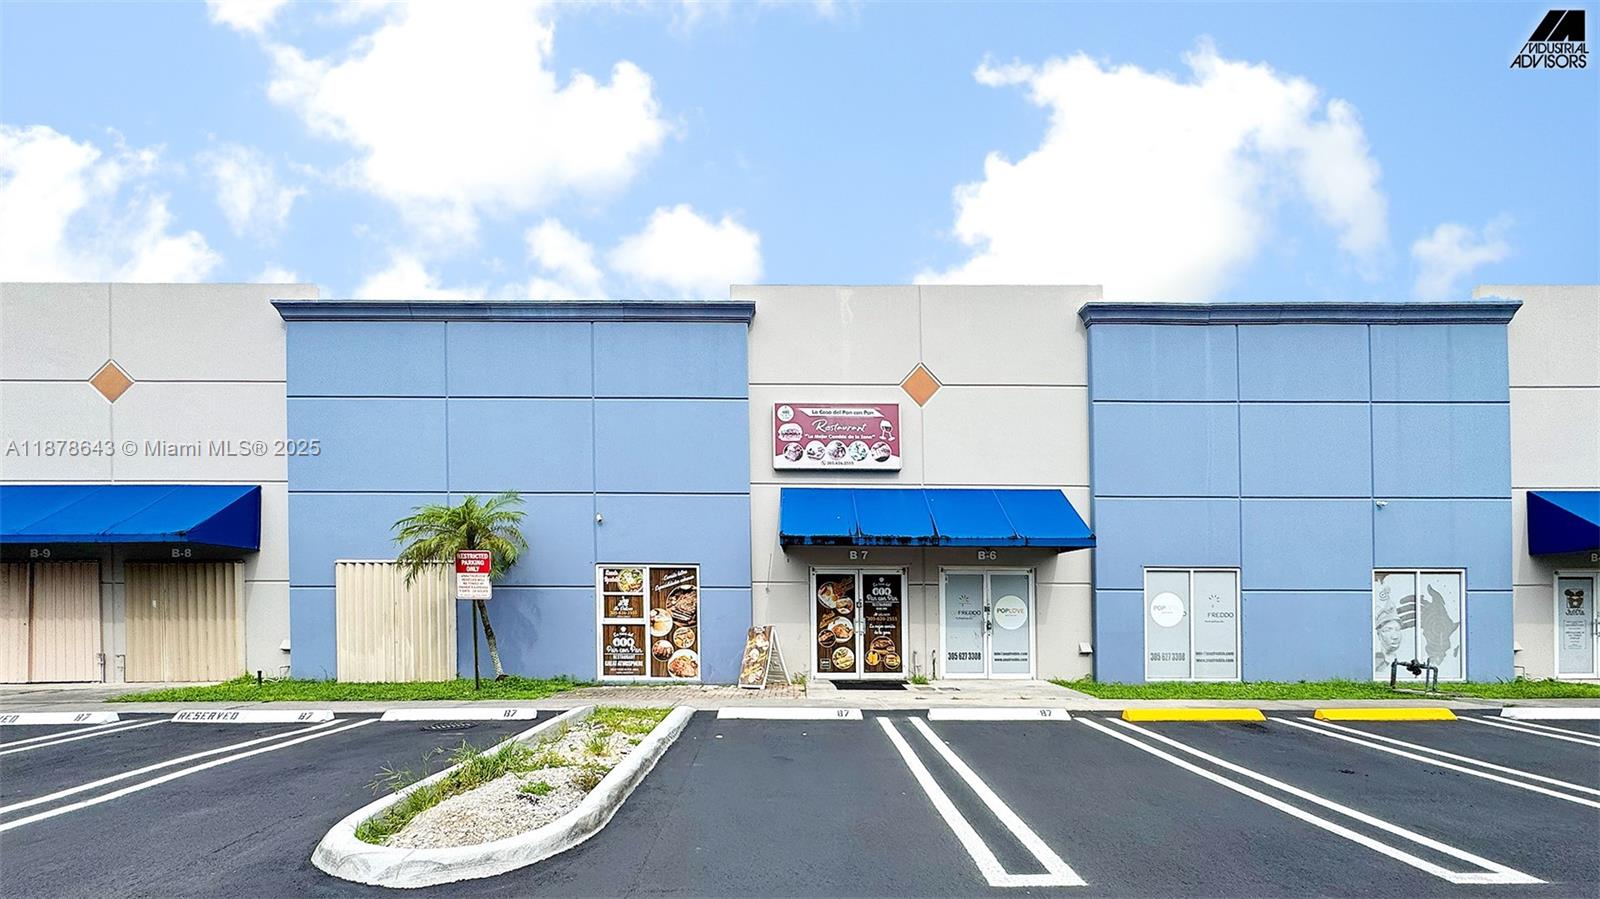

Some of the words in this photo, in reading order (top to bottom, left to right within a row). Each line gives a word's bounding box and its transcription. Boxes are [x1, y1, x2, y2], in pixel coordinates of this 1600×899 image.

[811, 418, 867, 432] Restaurant
[30, 549, 50, 557] B-9
[171, 549, 192, 557] B-8
[978, 551, 997, 560] B-6
[947, 652, 958, 661] 305
[968, 652, 981, 661] 3308
[1150, 652, 1161, 661] 305
[1171, 652, 1186, 661] 3308
[177, 711, 240, 721] RESERVED
